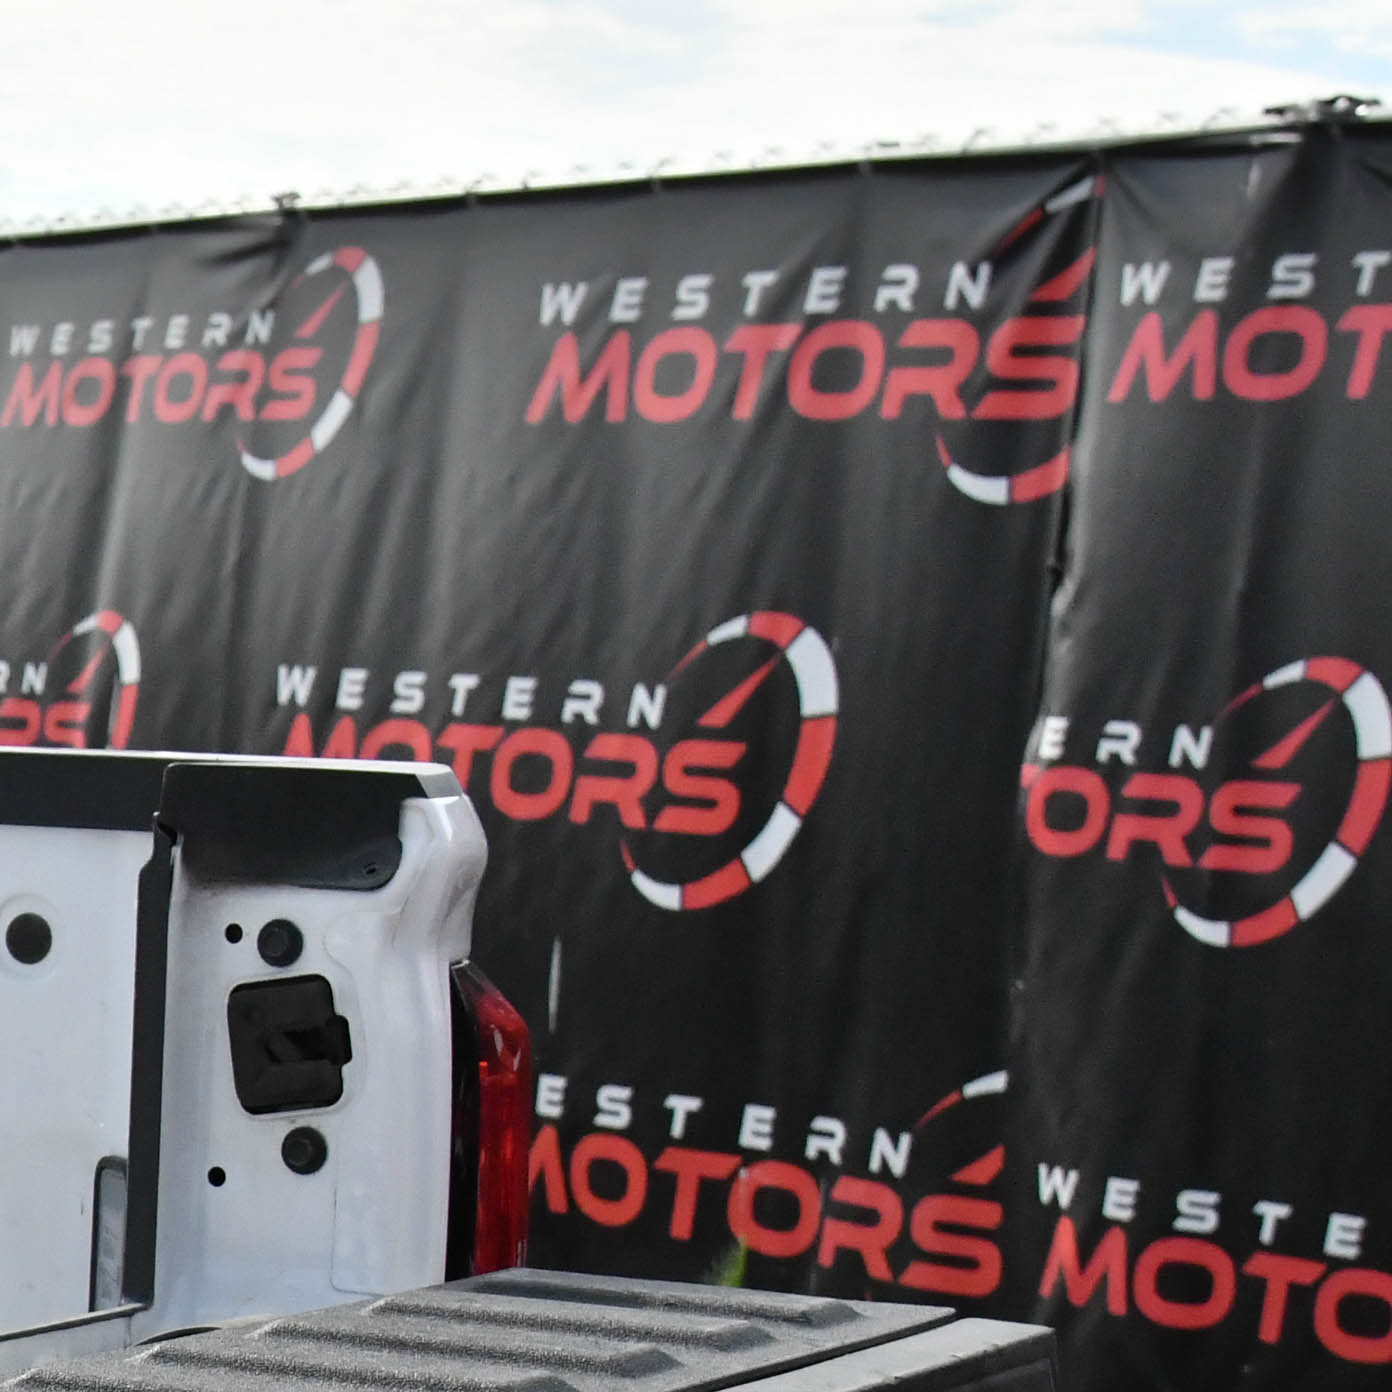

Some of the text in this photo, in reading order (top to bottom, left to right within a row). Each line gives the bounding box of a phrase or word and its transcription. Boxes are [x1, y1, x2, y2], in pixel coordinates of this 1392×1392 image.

[540, 260, 994, 326] WESTERN
[1120, 252, 1392, 307] WEST
[9, 310, 275, 357] WESTERN
[524, 313, 1085, 426] MOTORS
[1106, 303, 1392, 403] MOT
[0, 346, 324, 428] MOTORS
[276, 665, 666, 730] WESTERN
[1038, 716, 1214, 769] ERN
[1020, 763, 1302, 874] ORS
[535, 1073, 913, 1179] ESTERN
[1038, 1161, 1368, 1260] WESTE
[1039, 1215, 1392, 1364] MOTO
